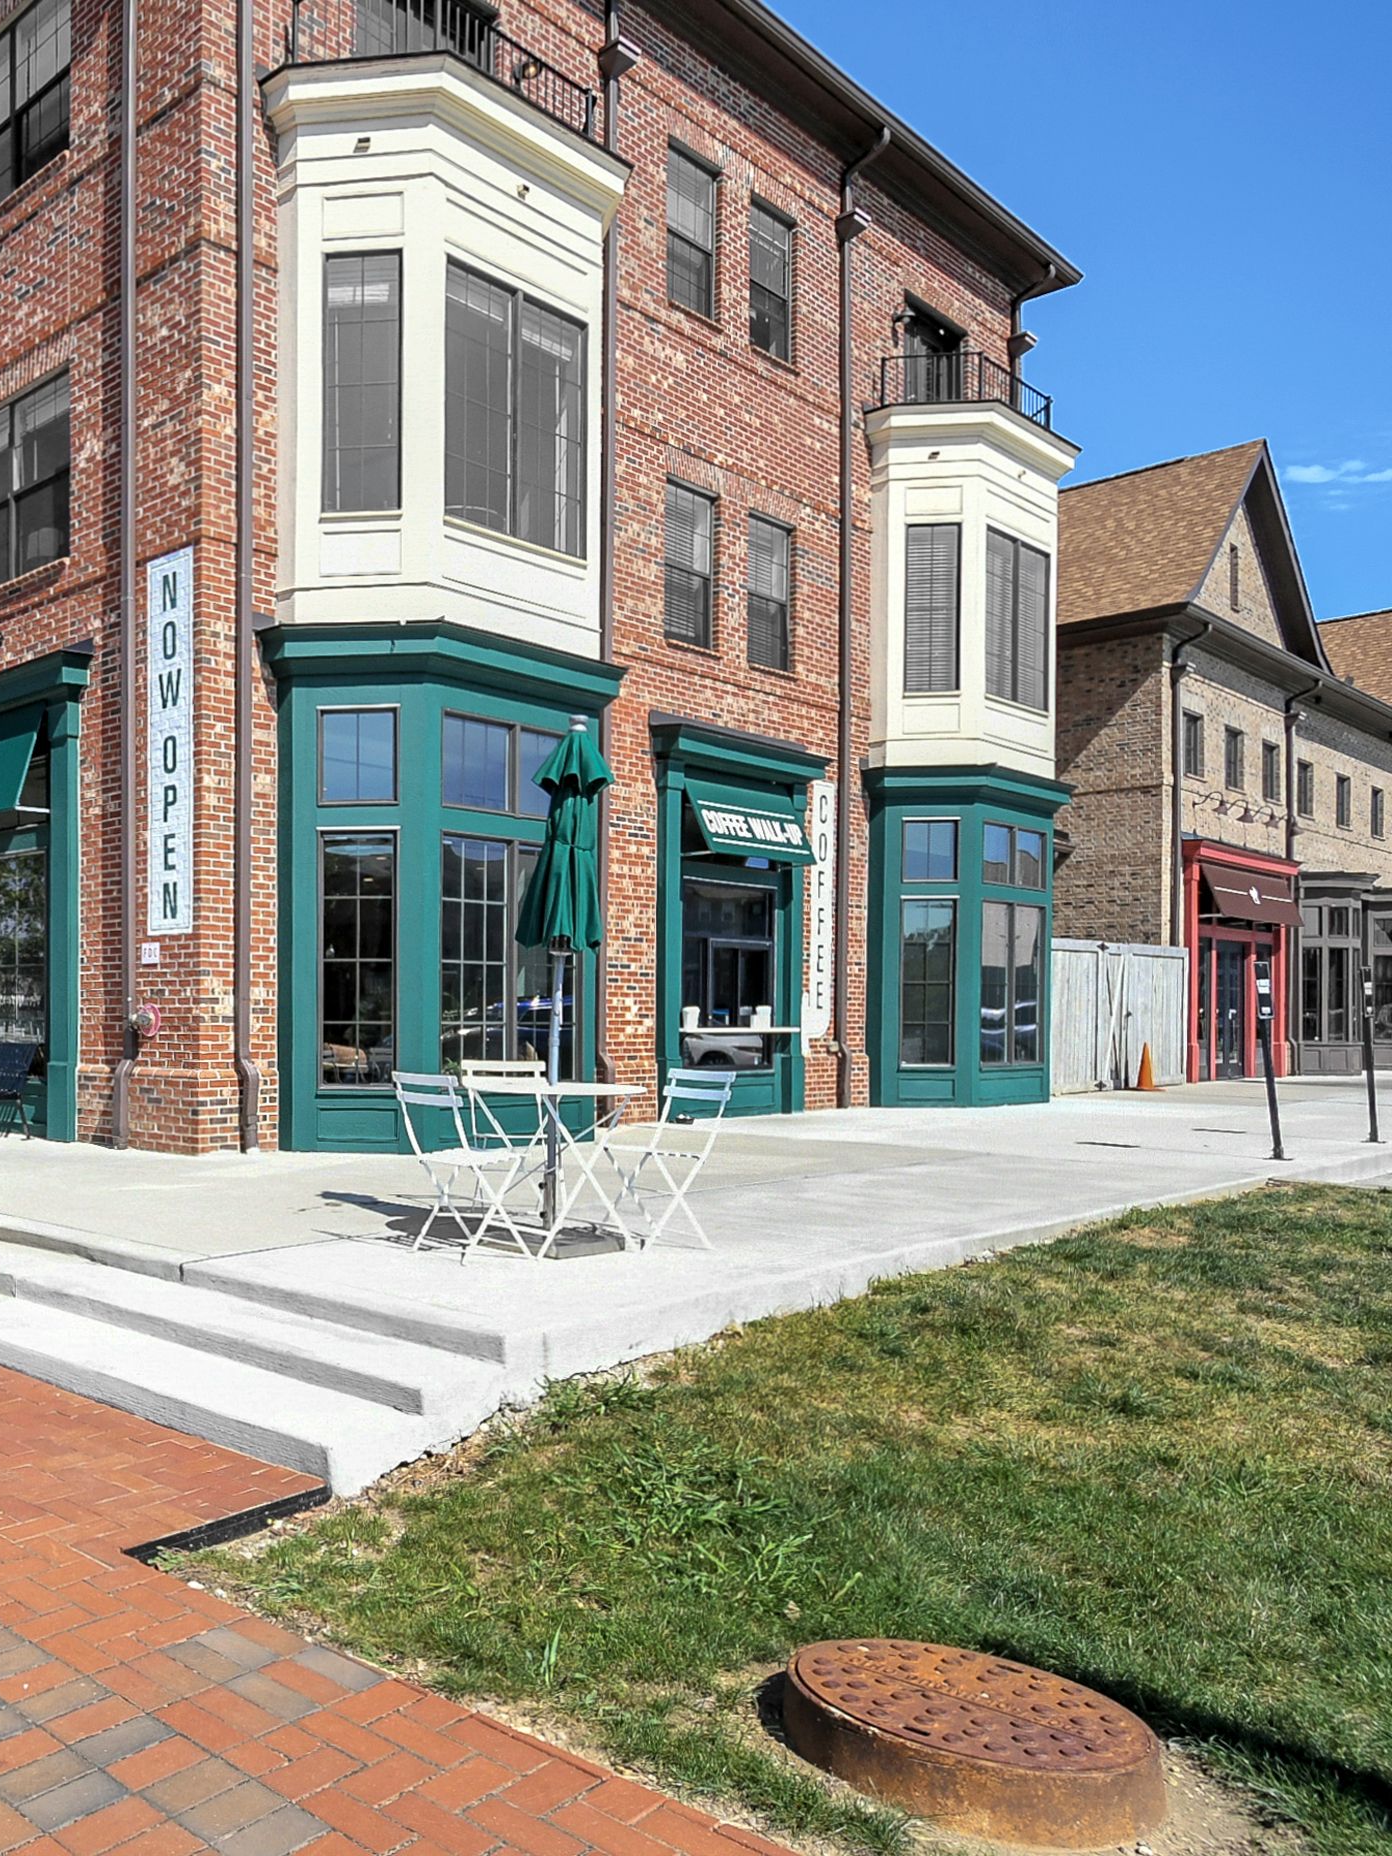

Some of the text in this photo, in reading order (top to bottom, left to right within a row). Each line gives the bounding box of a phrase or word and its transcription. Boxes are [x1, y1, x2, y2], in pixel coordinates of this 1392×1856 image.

[158, 571, 182, 920] NOW OPEN
[701, 809, 803, 846] COFFEE WALK-UP
[816, 794, 828, 1010] COFFEE
